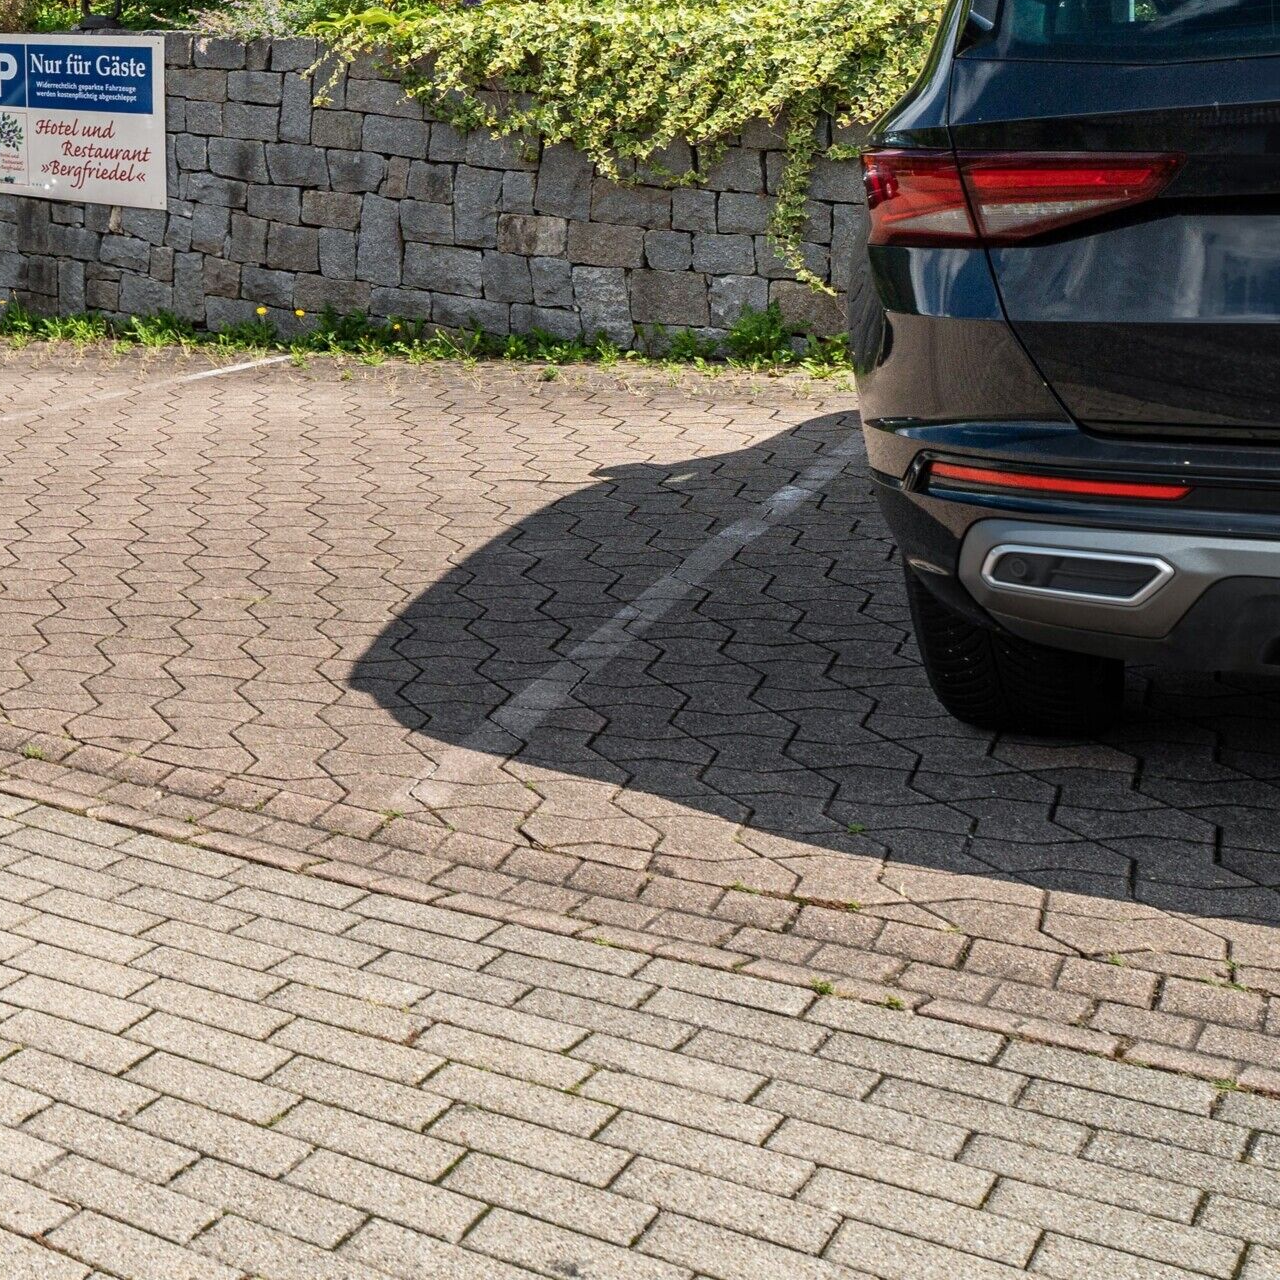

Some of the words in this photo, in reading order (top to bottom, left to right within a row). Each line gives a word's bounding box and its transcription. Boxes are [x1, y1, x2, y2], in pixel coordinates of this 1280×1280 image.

[30, 53, 62, 74] Nur
[66, 53, 92, 75] für
[95, 55, 146, 77] Gäste
[35, 81, 78, 90] Widerrechtlich
[78, 83, 104, 91] geparkte
[105, 84, 137, 94] Fahrzeuge
[57, 91, 98, 102] kostenpflichtig
[98, 93, 137, 103] abgeschleppt
[35, 118, 79, 136] Hotel
[82, 120, 116, 139] und
[61, 140, 152, 162] Restaurant
[40, 160, 146, 189] »Bergfriedel«
